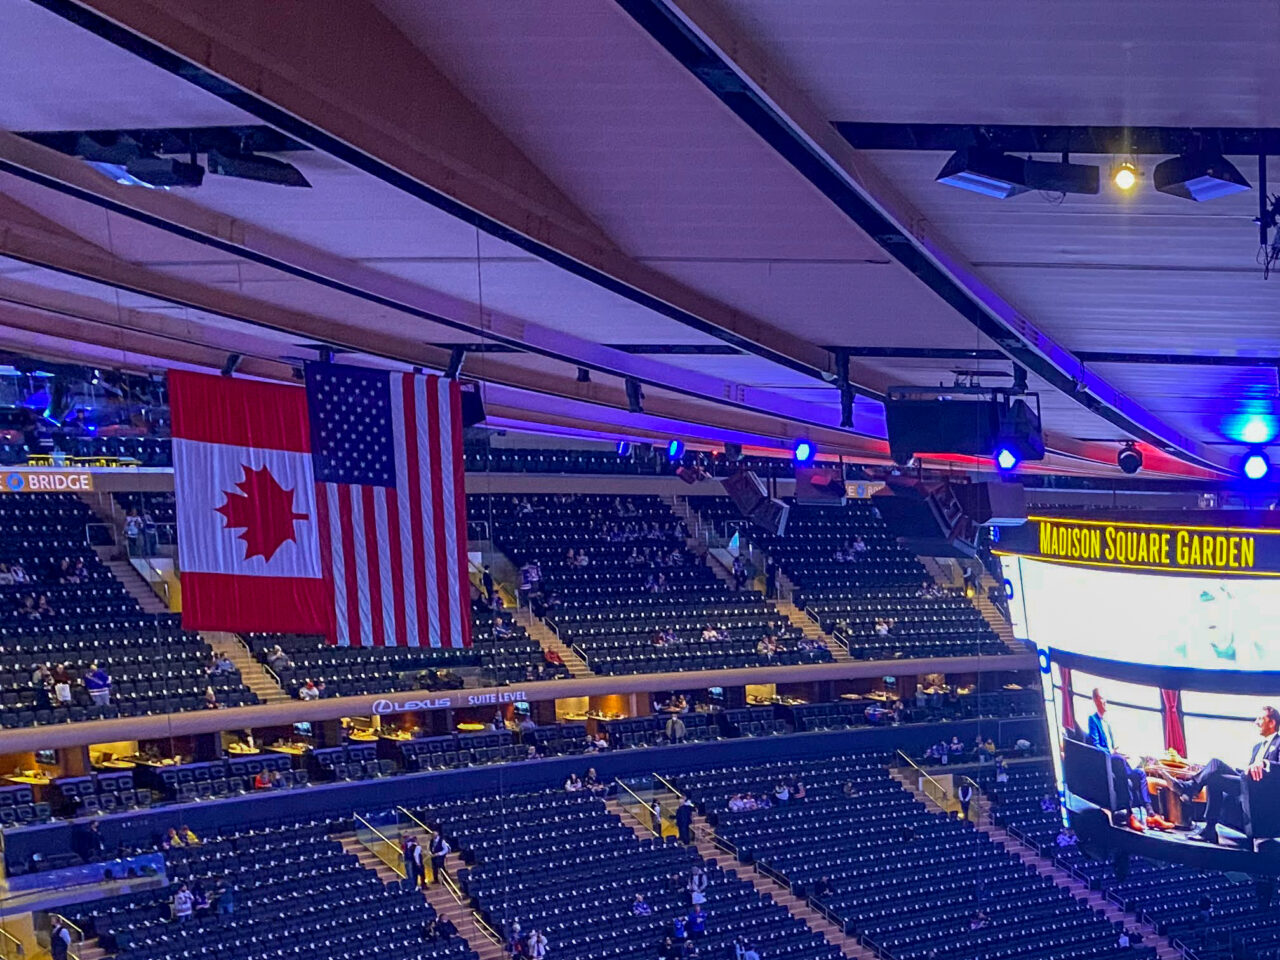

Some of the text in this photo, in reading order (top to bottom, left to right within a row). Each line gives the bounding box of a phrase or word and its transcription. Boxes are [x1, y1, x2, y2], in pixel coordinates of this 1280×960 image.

[28, 474, 90, 490] BRIDGE
[1039, 522, 1255, 568] MADISON SQUARE GARDEN
[395, 697, 451, 711] LEXUS
[468, 691, 528, 705] SUITE LEVEL
